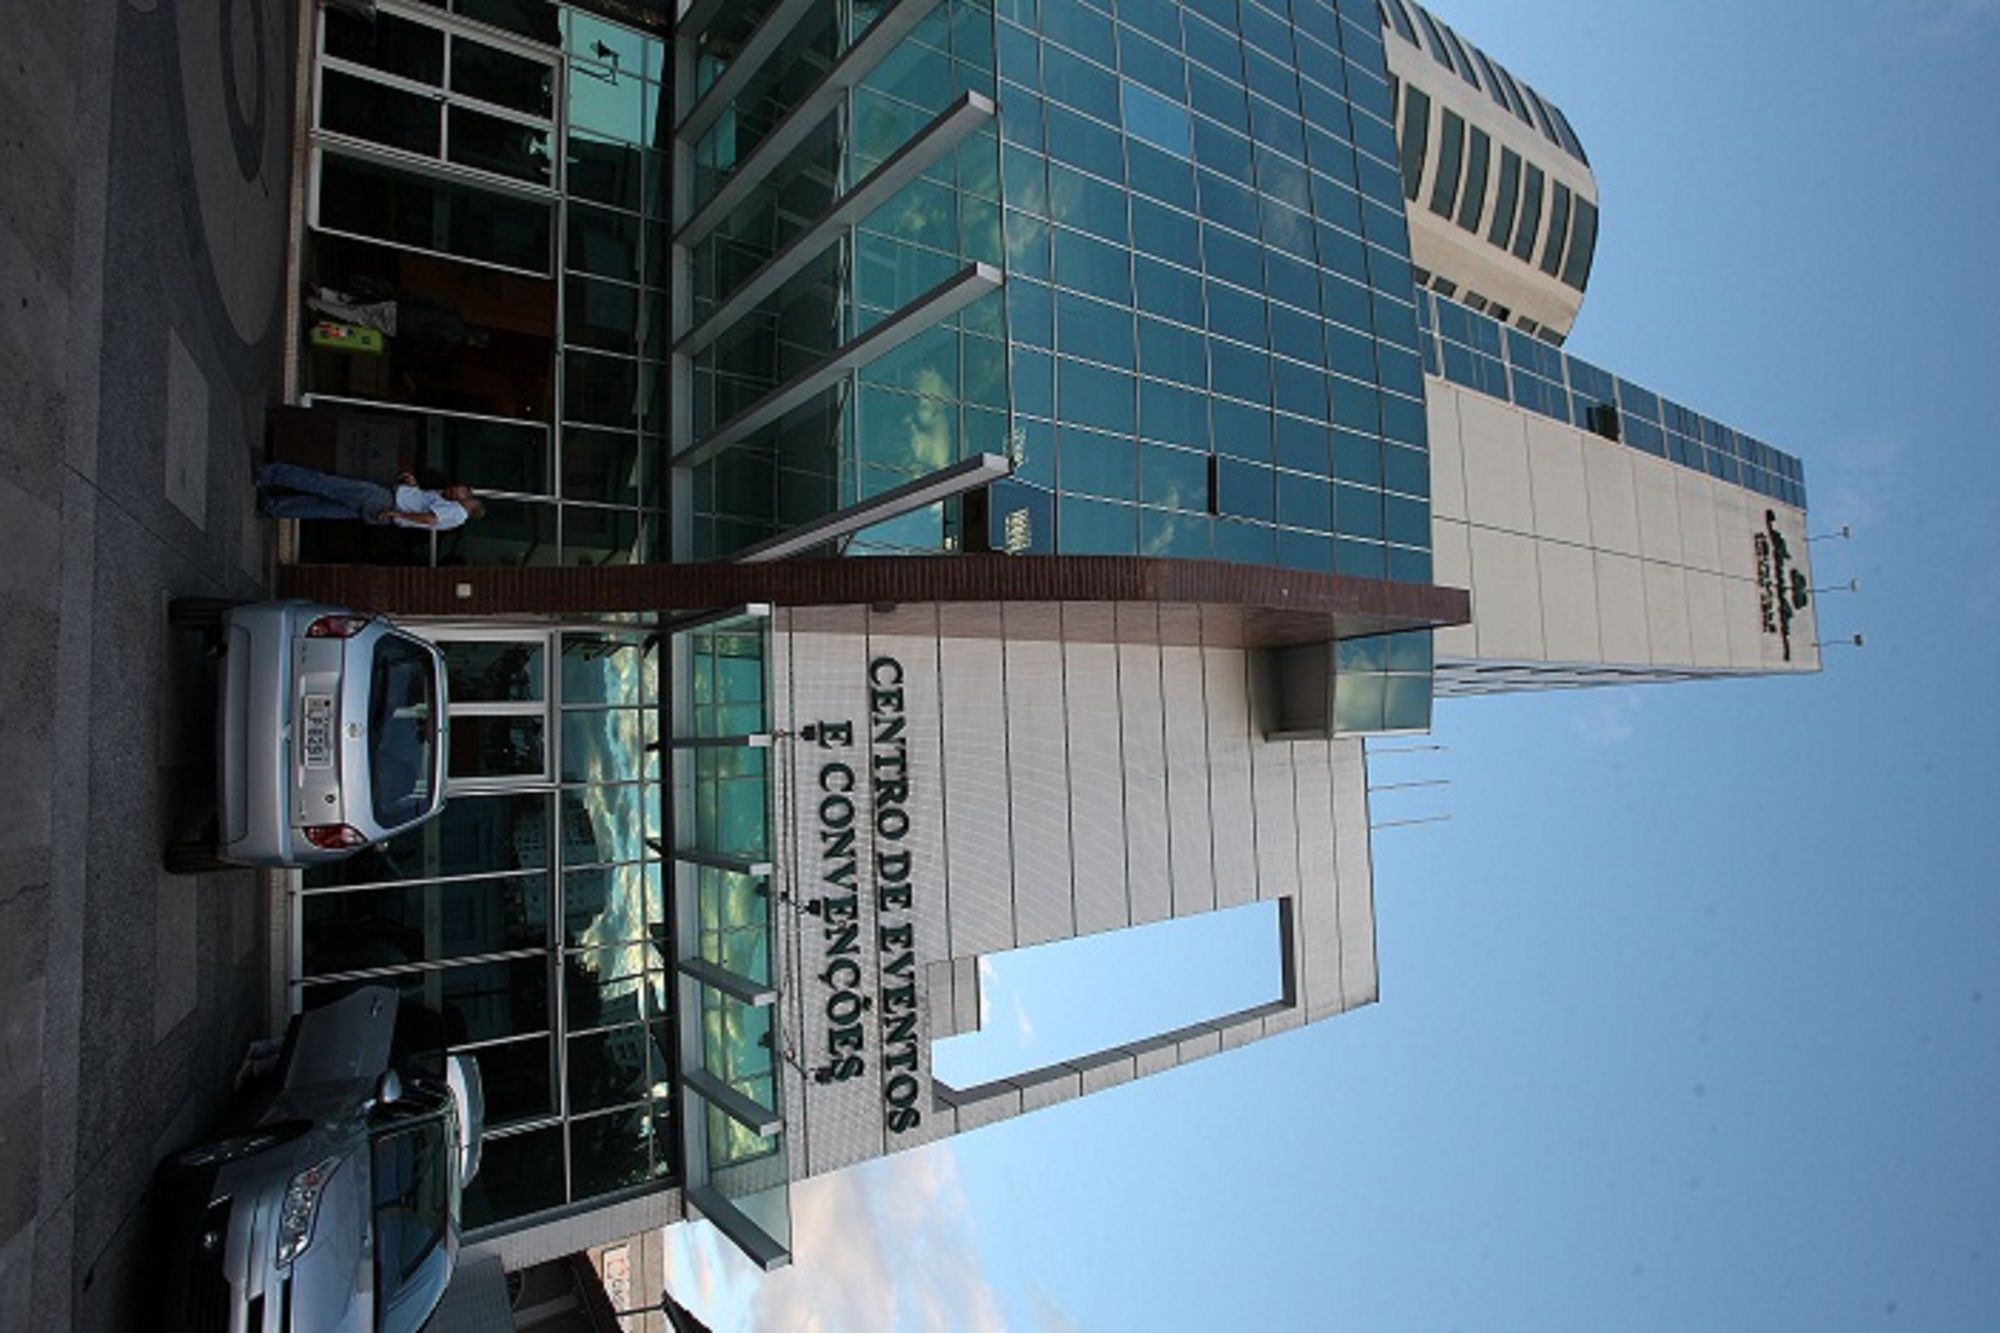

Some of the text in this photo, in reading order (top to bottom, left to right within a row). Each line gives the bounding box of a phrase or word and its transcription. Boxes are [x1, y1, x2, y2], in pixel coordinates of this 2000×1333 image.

[818, 719, 873, 1084] E CONVENÇÕES
[869, 656, 921, 1135] CENTRO DE EVENTOS
